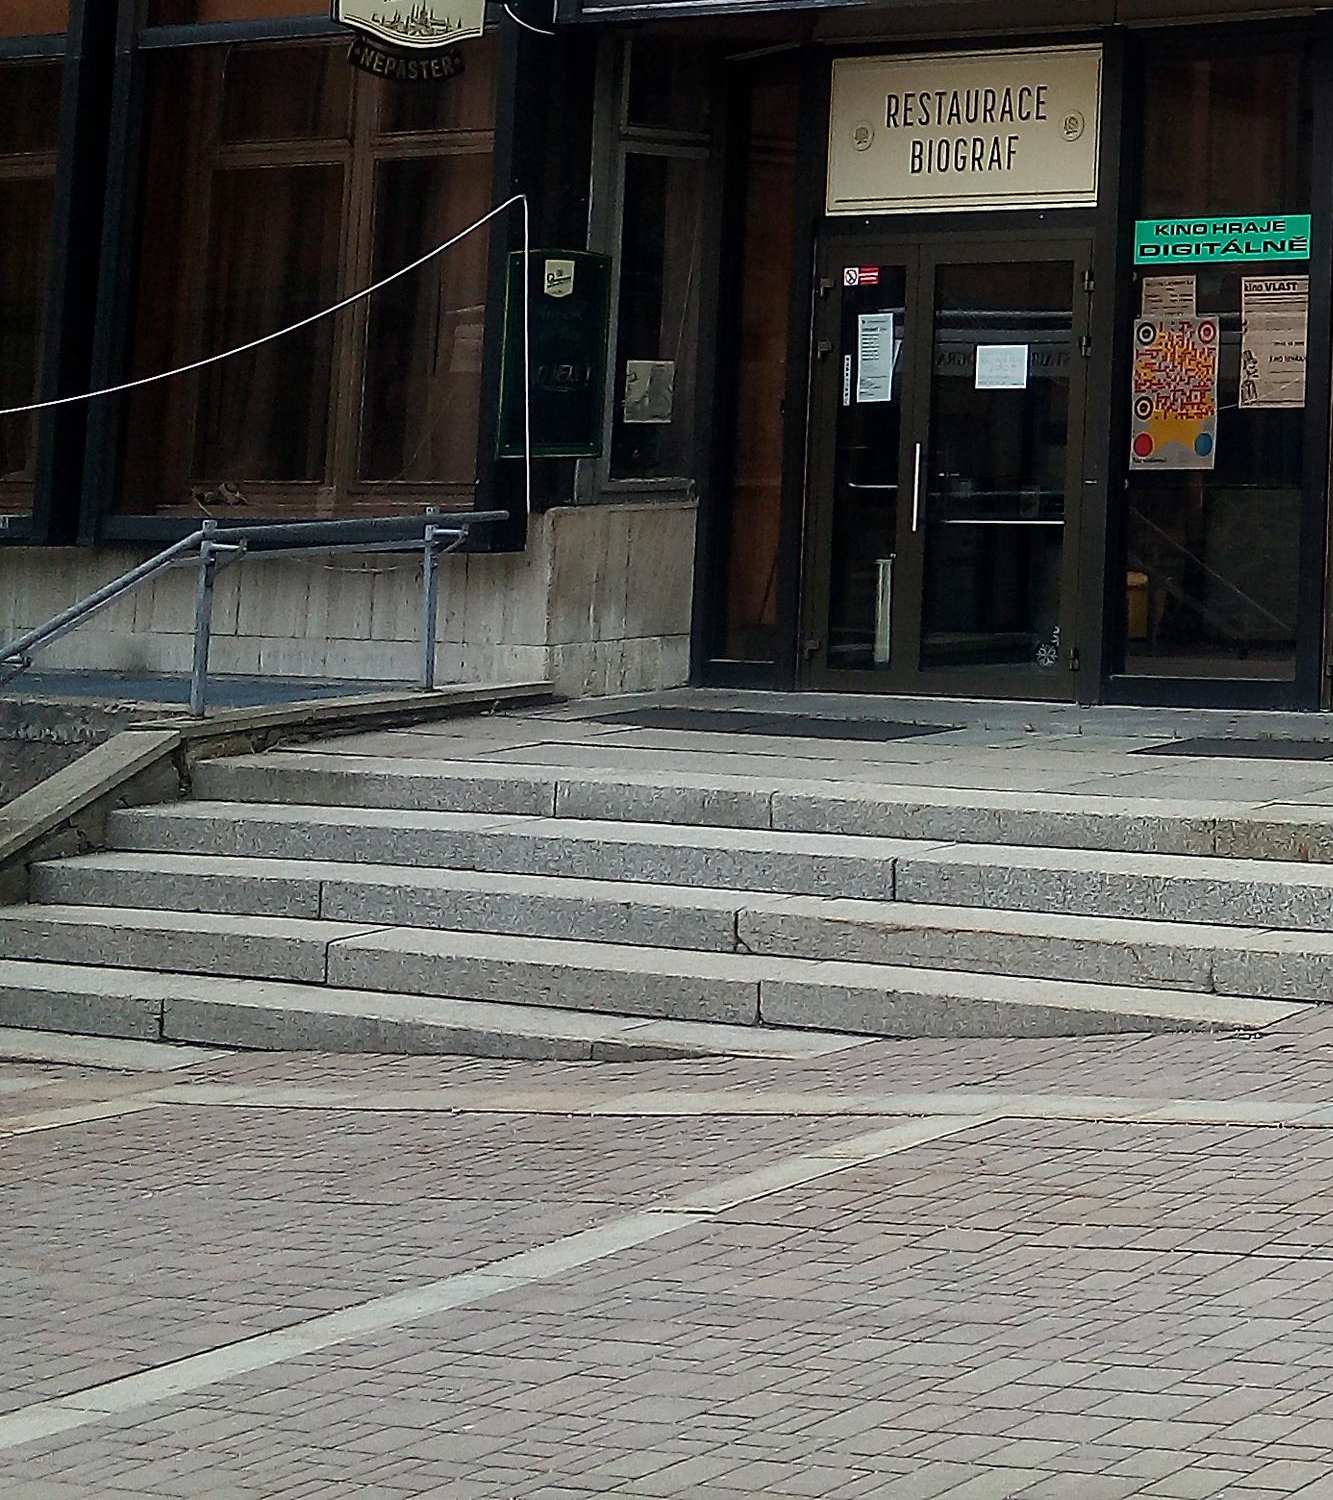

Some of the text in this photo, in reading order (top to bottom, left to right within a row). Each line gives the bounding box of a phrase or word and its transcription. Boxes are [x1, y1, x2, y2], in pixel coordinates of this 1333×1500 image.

[886, 86, 1048, 128] RESTAURACE
[910, 136, 1019, 174] BIOGRAF
[1155, 221, 1286, 237] KINO HRAJE
[1138, 235, 1308, 257] DIGITÁLNĚ
[1265, 281, 1299, 292] VLAST
